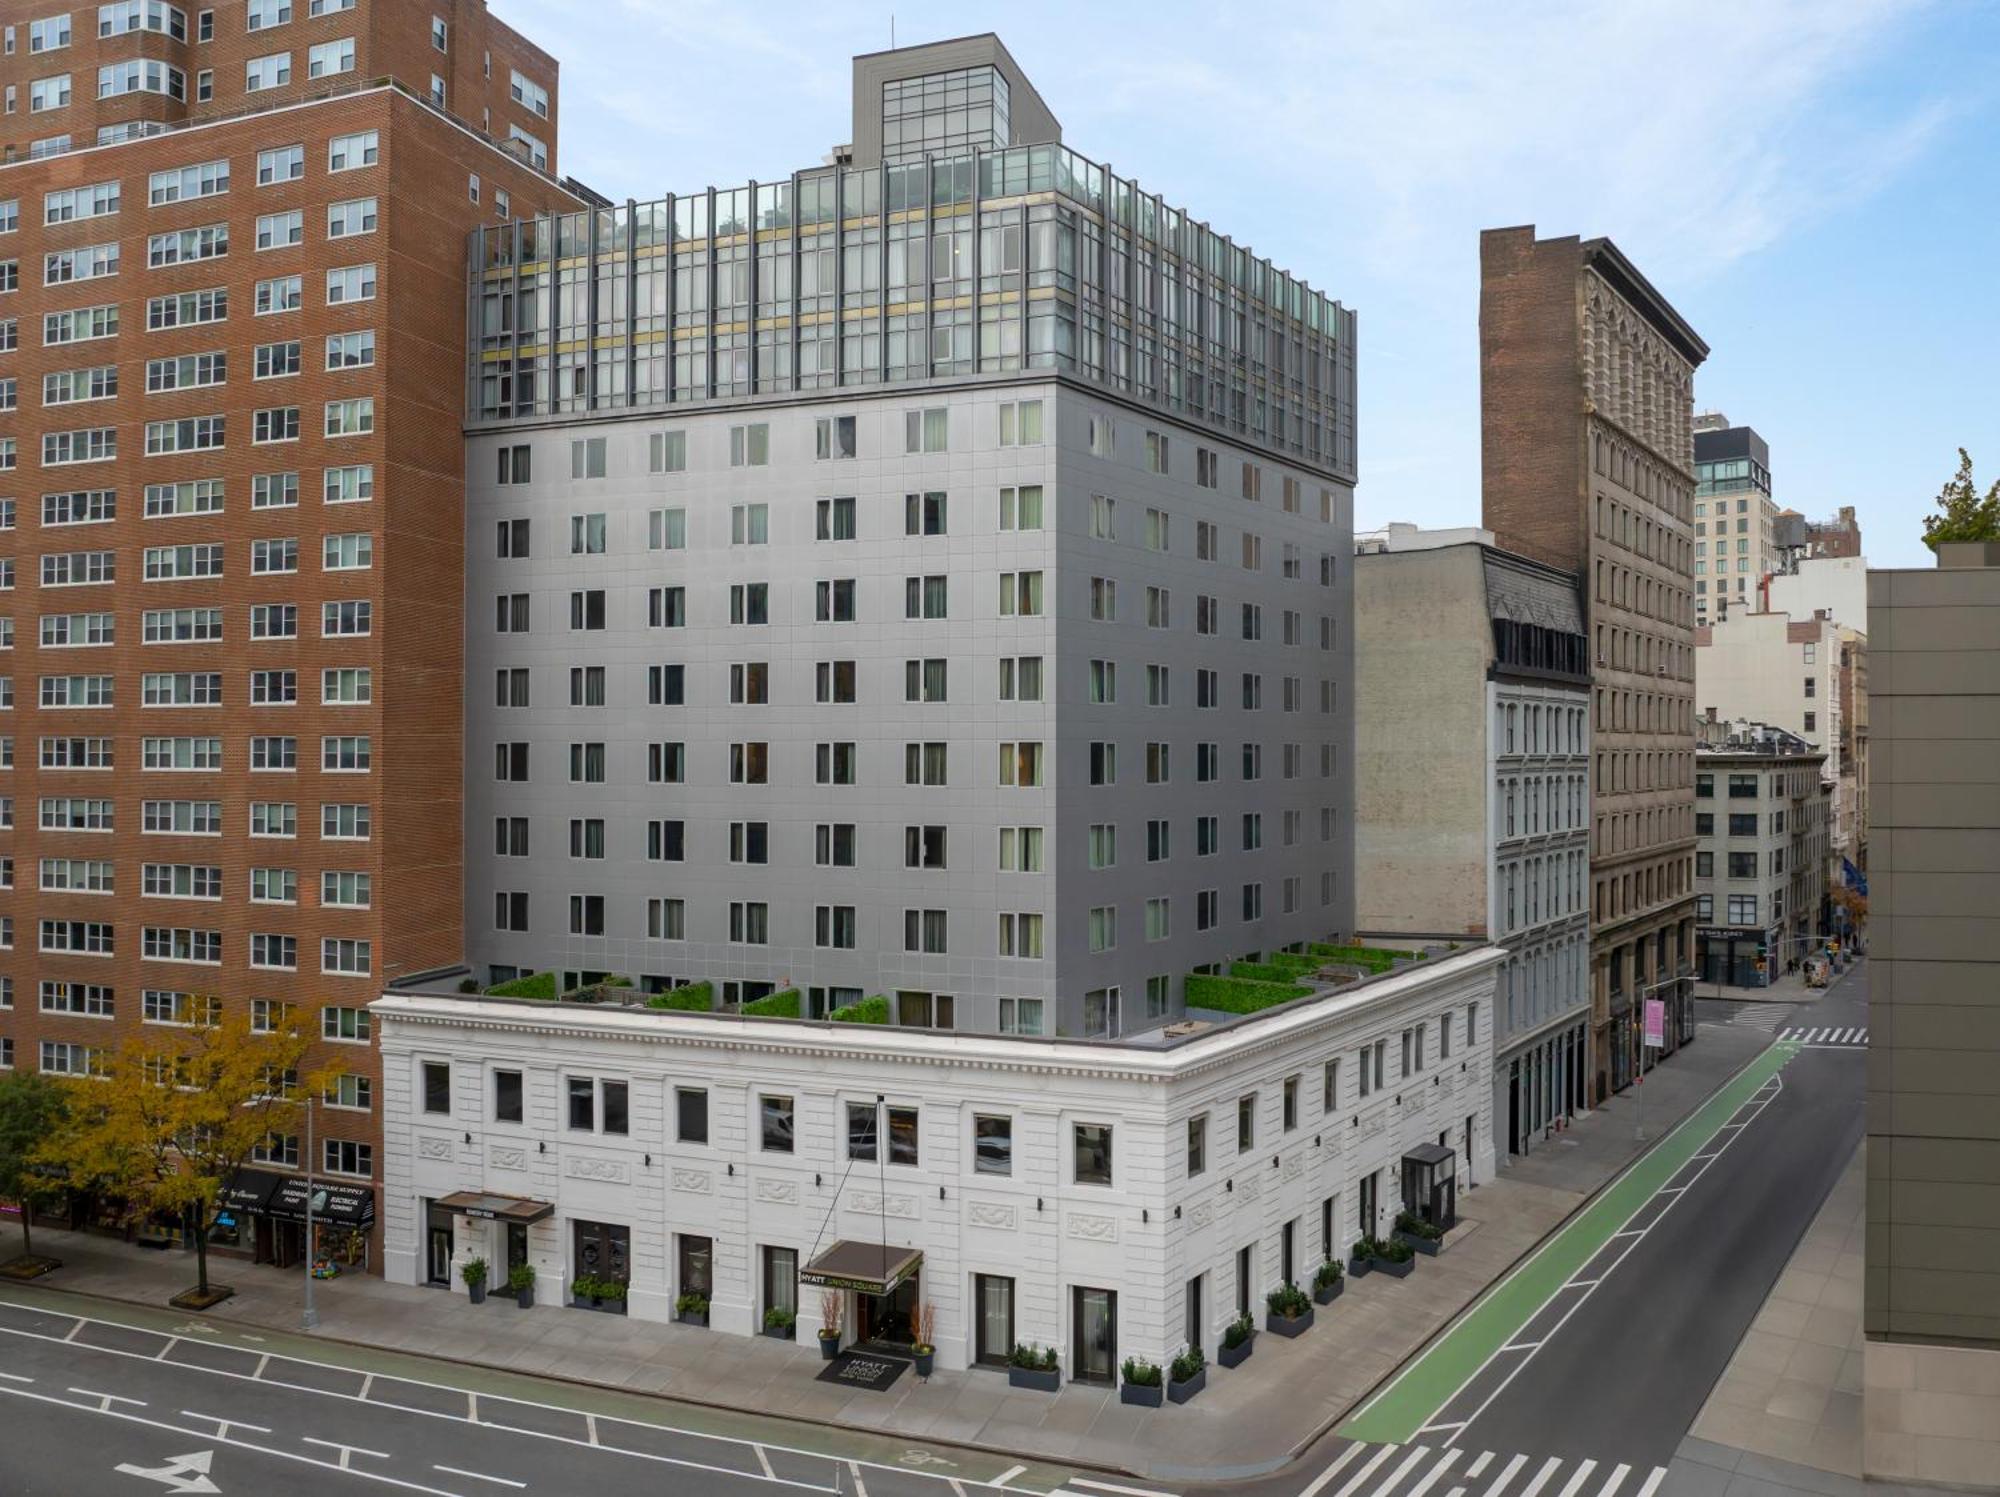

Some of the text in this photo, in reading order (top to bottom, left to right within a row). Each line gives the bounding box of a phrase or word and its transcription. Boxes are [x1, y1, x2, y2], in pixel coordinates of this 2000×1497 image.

[801, 1273, 826, 1284] HYATT
[853, 1281, 882, 1292] SQUARE
[850, 1359, 892, 1370] HYATT
